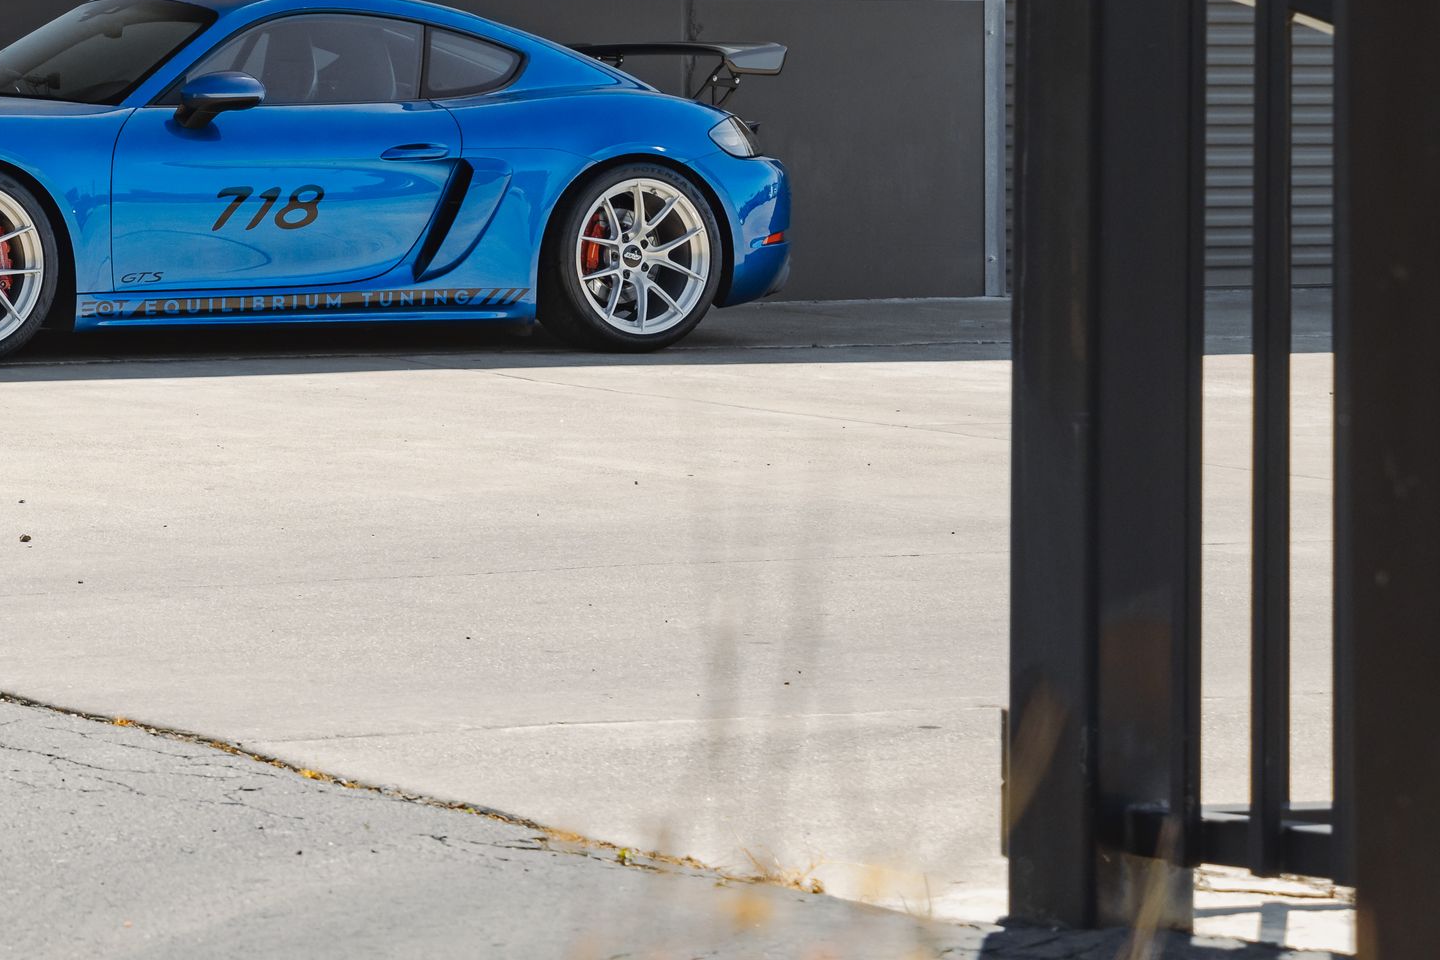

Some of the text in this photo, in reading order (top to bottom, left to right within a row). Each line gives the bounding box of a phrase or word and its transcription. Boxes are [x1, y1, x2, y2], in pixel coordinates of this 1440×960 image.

[211, 183, 325, 232] 718
[120, 271, 164, 284] GTS
[144, 292, 343, 317] EQUILIBRIUM
[361, 288, 471, 309] TUNING
